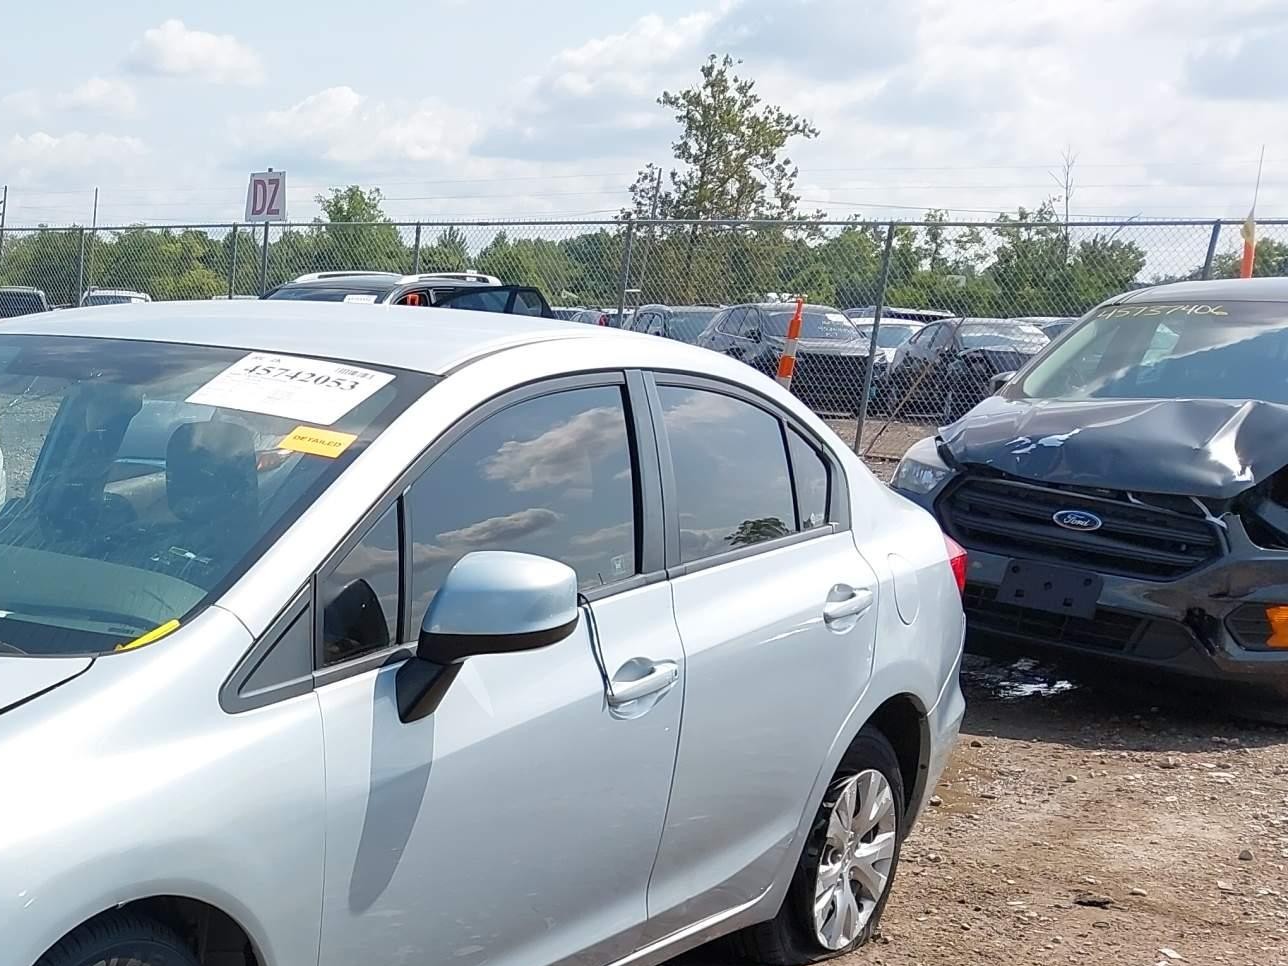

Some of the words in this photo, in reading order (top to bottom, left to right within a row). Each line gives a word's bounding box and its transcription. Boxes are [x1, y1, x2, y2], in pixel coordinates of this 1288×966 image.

[252, 178, 280, 215] DZ
[243, 364, 360, 391] 45742053
[292, 434, 343, 448] DETAILED
